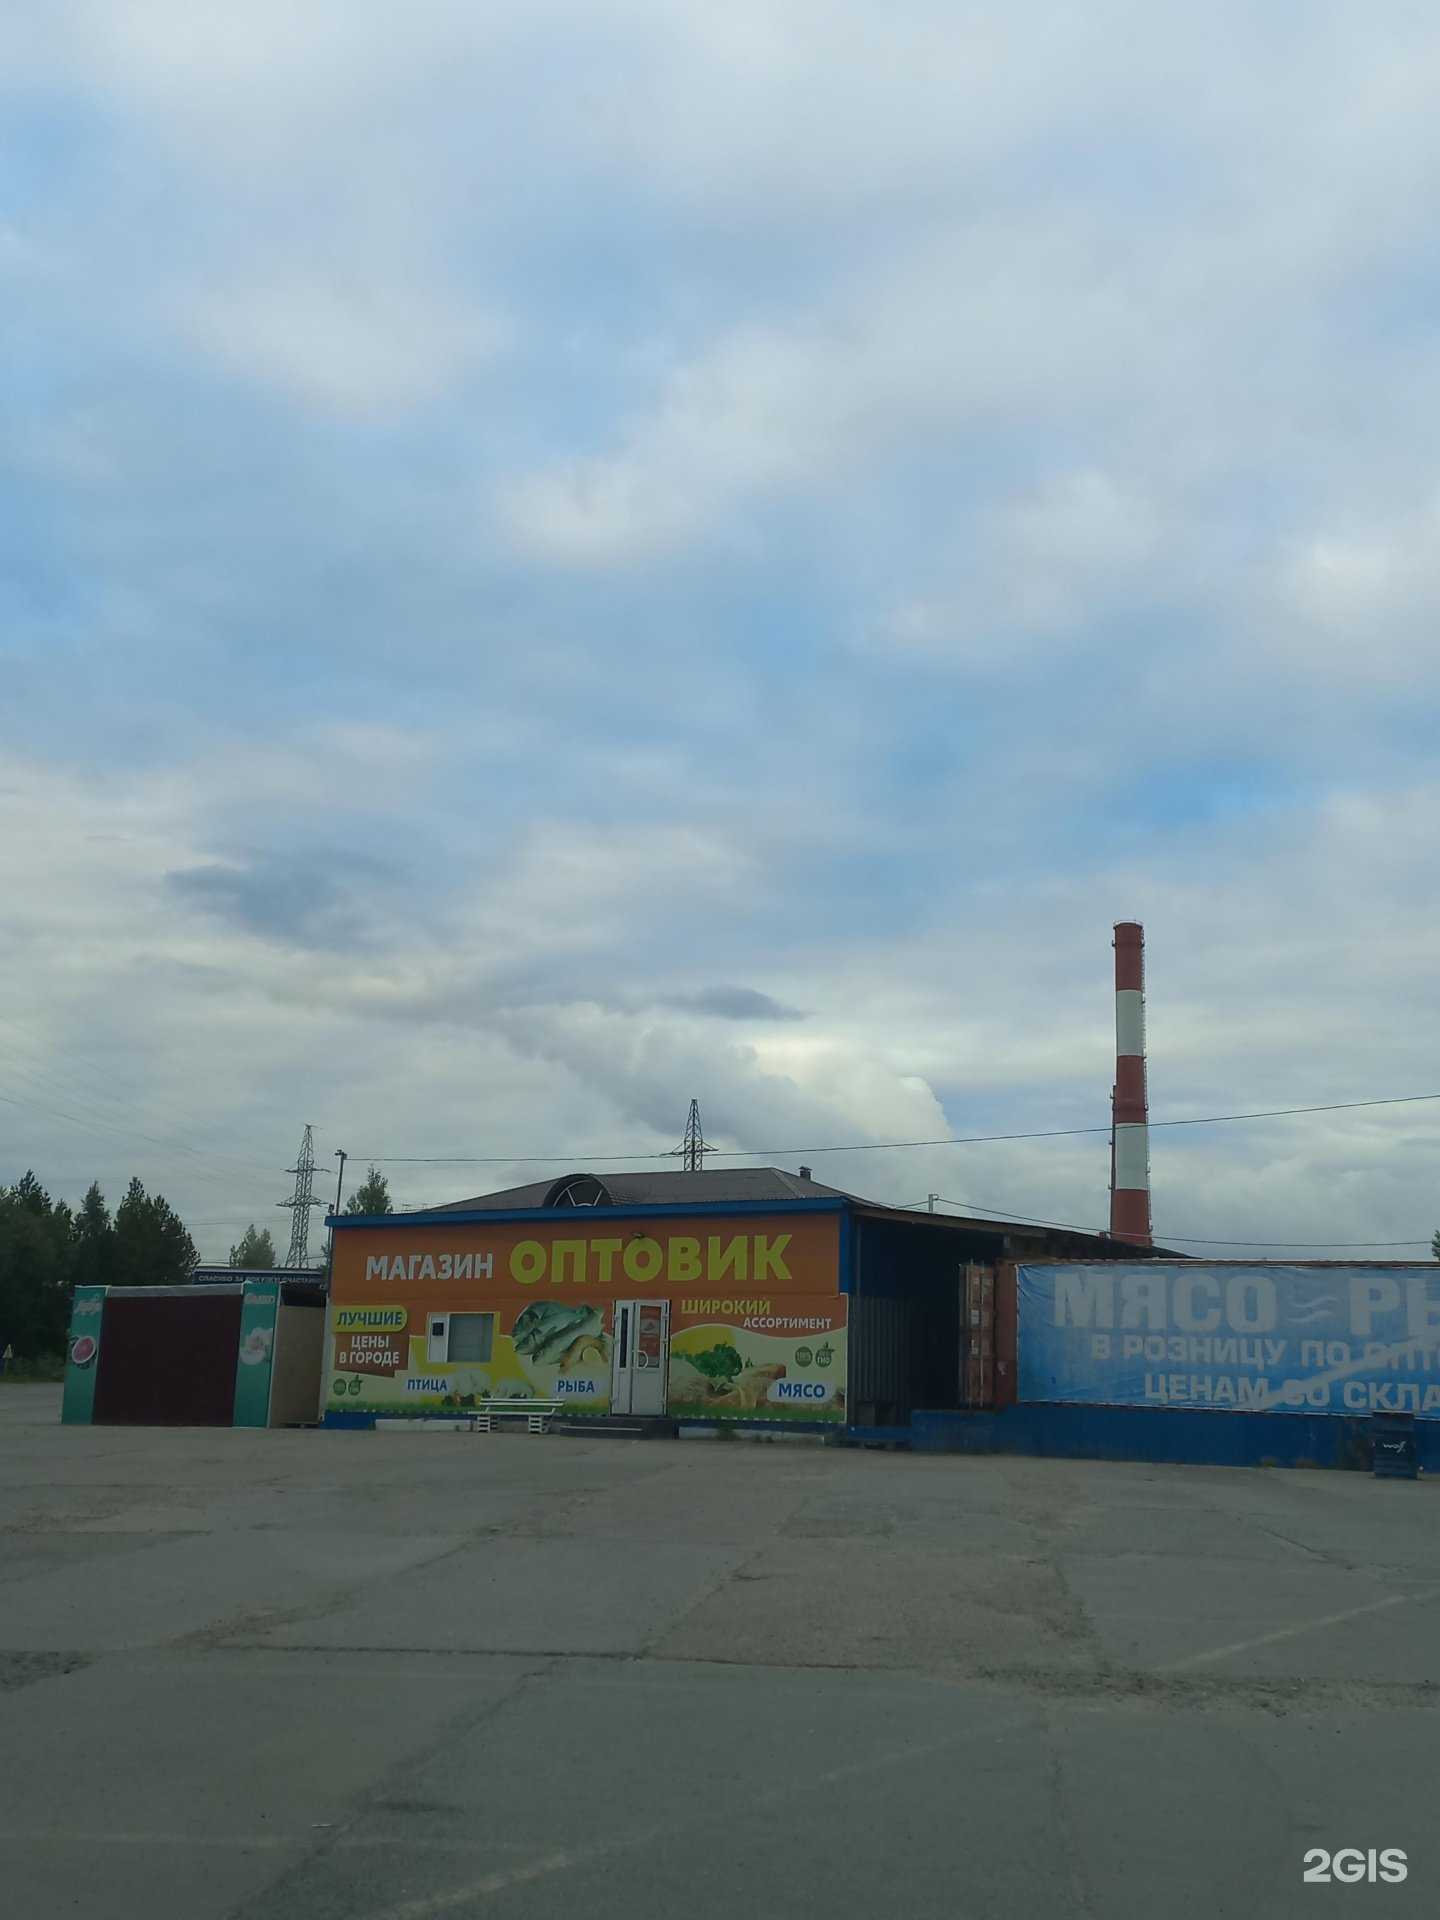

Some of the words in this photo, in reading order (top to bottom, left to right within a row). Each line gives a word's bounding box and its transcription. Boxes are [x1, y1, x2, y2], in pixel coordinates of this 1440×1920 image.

[366, 1253, 494, 1282] МАГАЗИН
[509, 1233, 793, 1285] ОПТОВИК
[681, 1297, 771, 1317] ШИРОКИЙ
[1053, 1273, 1279, 1334] МЯСО
[337, 1310, 403, 1328] ЛУЧШИЕ
[743, 1316, 832, 1330] АССОРТИМЕНТ
[351, 1334, 390, 1351] ЦЕНЫ
[339, 1351, 351, 1365] В
[356, 1350, 400, 1367] ГОРОДЕ
[1091, 1334, 1111, 1360] В
[1122, 1335, 1286, 1370] РОЗНИЦУ
[1301, 1339, 1349, 1367] ПО
[407, 1377, 448, 1394] ПТИЦА
[557, 1378, 596, 1394] РЫБА
[778, 1383, 826, 1400] МЯСО
[1145, 1373, 1268, 1408] ЦЕНАМ
[1344, 1381, 1440, 1412] СКЛА
